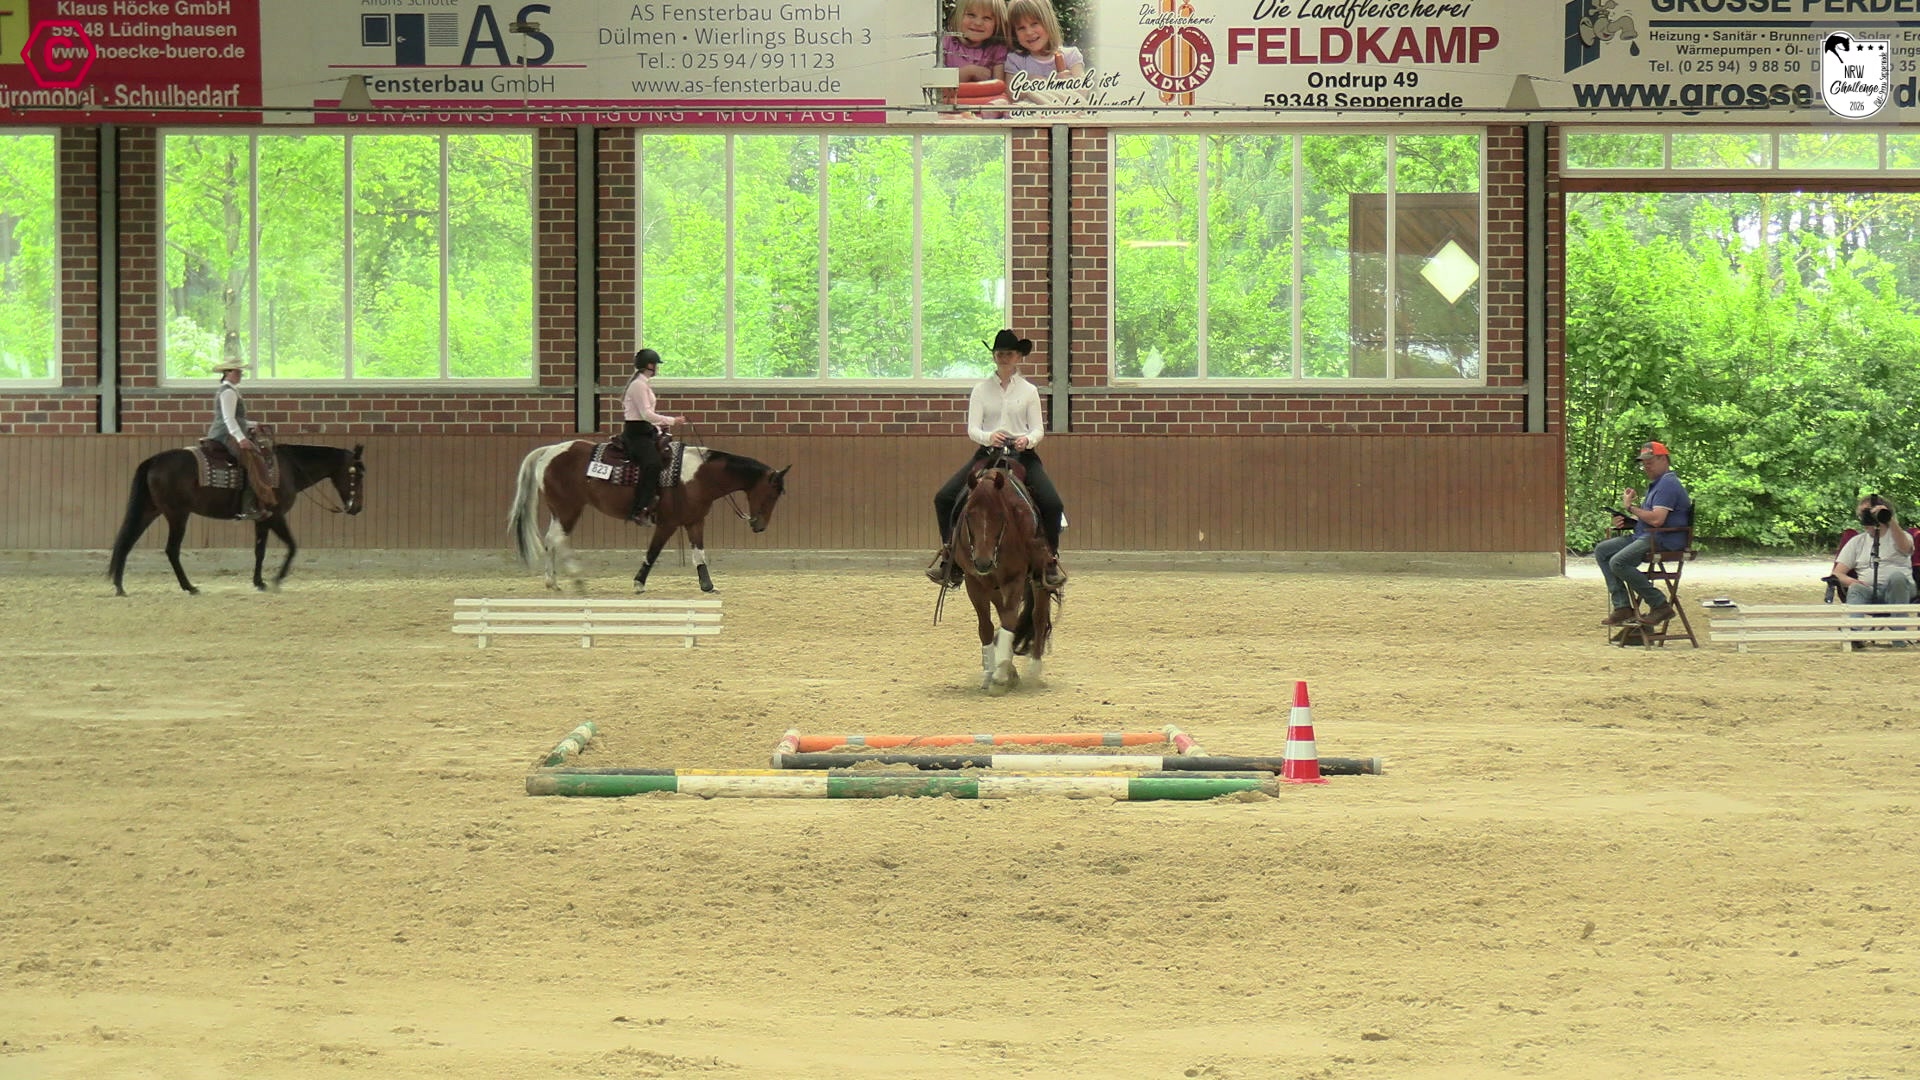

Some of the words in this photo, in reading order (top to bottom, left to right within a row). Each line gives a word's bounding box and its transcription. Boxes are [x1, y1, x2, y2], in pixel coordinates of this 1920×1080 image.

[57, 1, 108, 16] Klaus
[113, 0, 170, 16] Höcke
[175, 1, 231, 16] GmbH
[631, 5, 655, 21] AS
[663, 4, 772, 21] Fensterbau
[780, 4, 841, 21] GmbH
[1140, 3, 1156, 15] Die
[1253, 0, 1291, 20] Die
[1297, 0, 1473, 28] Landfleischerei
[110, 22, 237, 40] Lüdinghausen
[461, 4, 555, 66] AS
[600, 28, 676, 45] Dülmen
[695, 28, 786, 49] Wierlings
[795, 28, 853, 45] Busch
[861, 28, 872, 45] 3
[1650, 31, 1700, 43] Heizung
[1713, 31, 1757, 41] Sanitär
[51, 44, 245, 59] wwwhoecke-buero.de
[1228, 26, 1499, 65] FELDKAMP
[1677, 45, 1771, 57] Wärmepumpen
[637, 53, 676, 69] Tel.:
[1650, 60, 1673, 72] Tel.
[1142, 53, 1212, 91] FELDKAMP
[364, 75, 484, 93] Fensterbau
[491, 75, 555, 93] GmbH
[632, 76, 841, 93] www.as-fensterbau.de
[1011, 69, 1095, 98] Geschmack
[1099, 71, 1120, 88] ist
[1308, 72, 1387, 91] Ondrup
[1394, 72, 1419, 87] 49
[114, 84, 240, 108] Schulbedarf
[1264, 93, 1328, 107] 59348
[591, 463, 608, 475] 823
